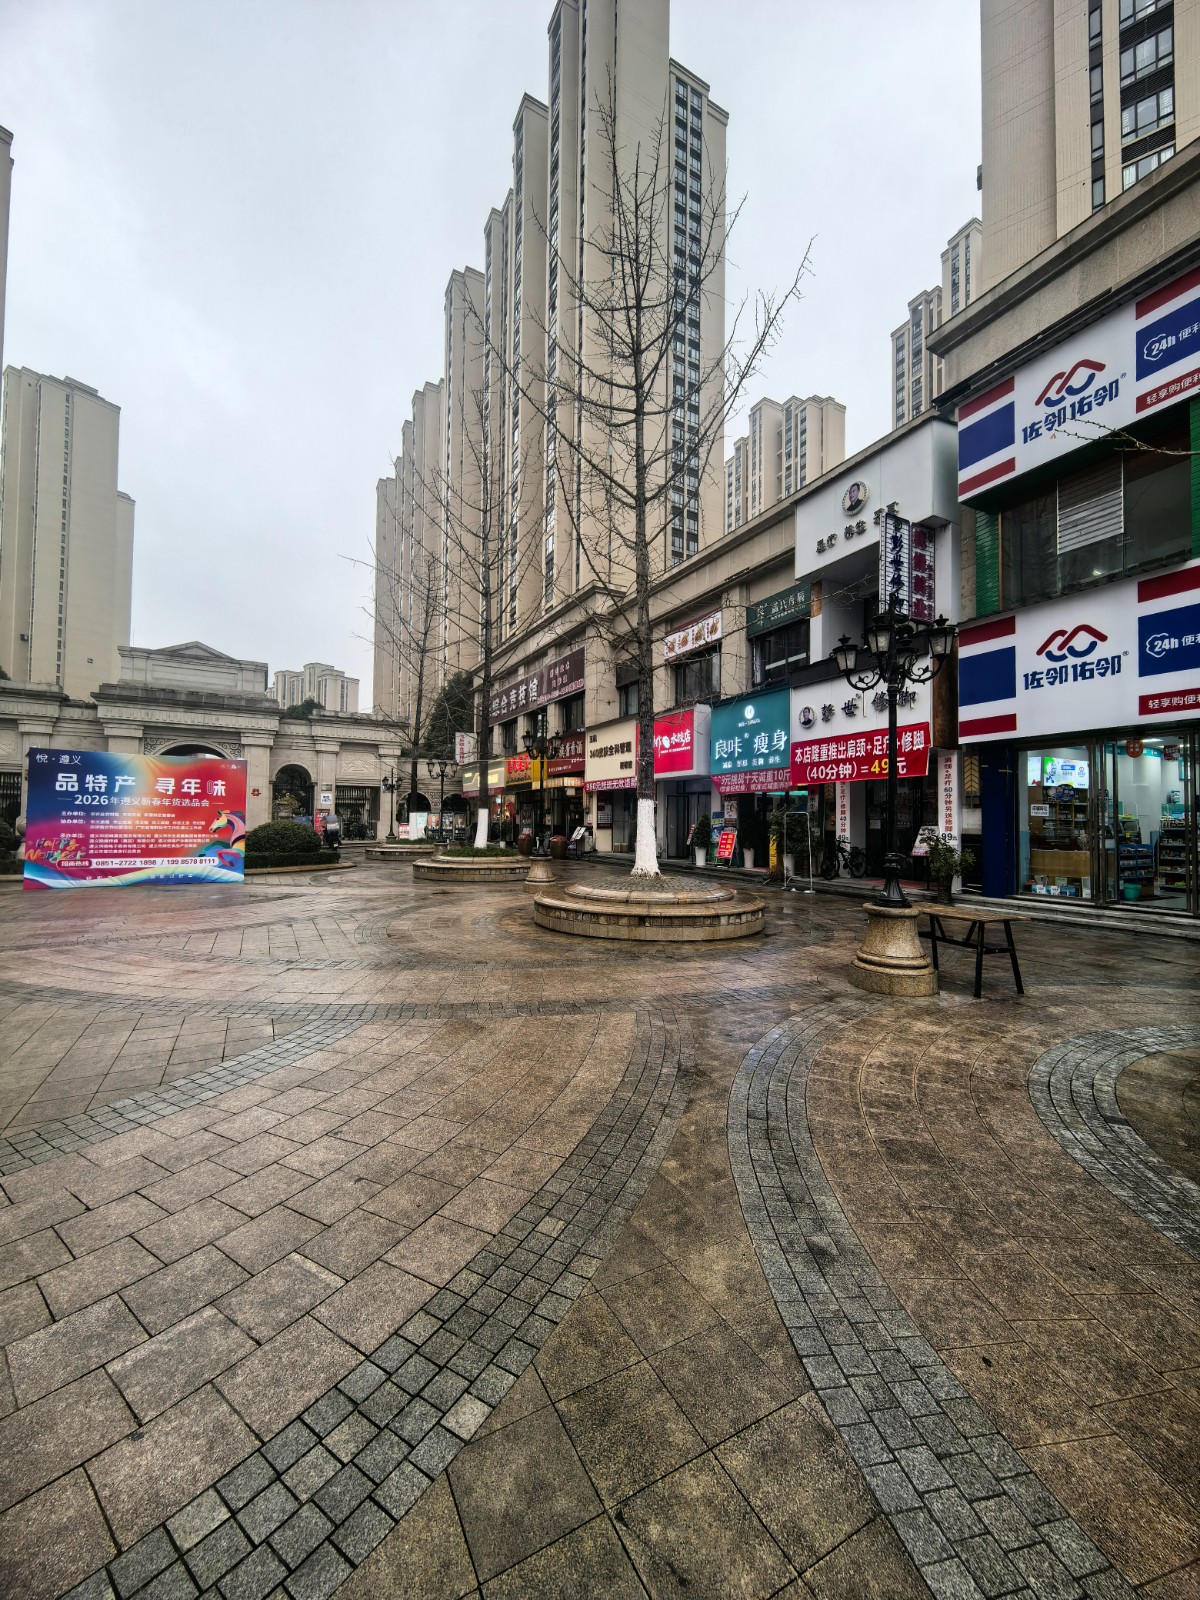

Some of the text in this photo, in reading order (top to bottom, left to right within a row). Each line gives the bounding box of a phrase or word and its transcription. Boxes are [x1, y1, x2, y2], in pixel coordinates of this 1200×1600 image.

[1151, 335, 1176, 356] 24h
[1021, 378, 1119, 445] 佐邻佑邻
[1154, 637, 1179, 652] 24h
[1023, 654, 1122, 690] 佐邻佑邻
[1148, 694, 1200, 709] 轻享购便
[753, 729, 788, 755] 瘦身
[55, 773, 226, 797] 品特产 寻年味
[74, 794, 210, 807] 2026年遵义新春年货选品会
